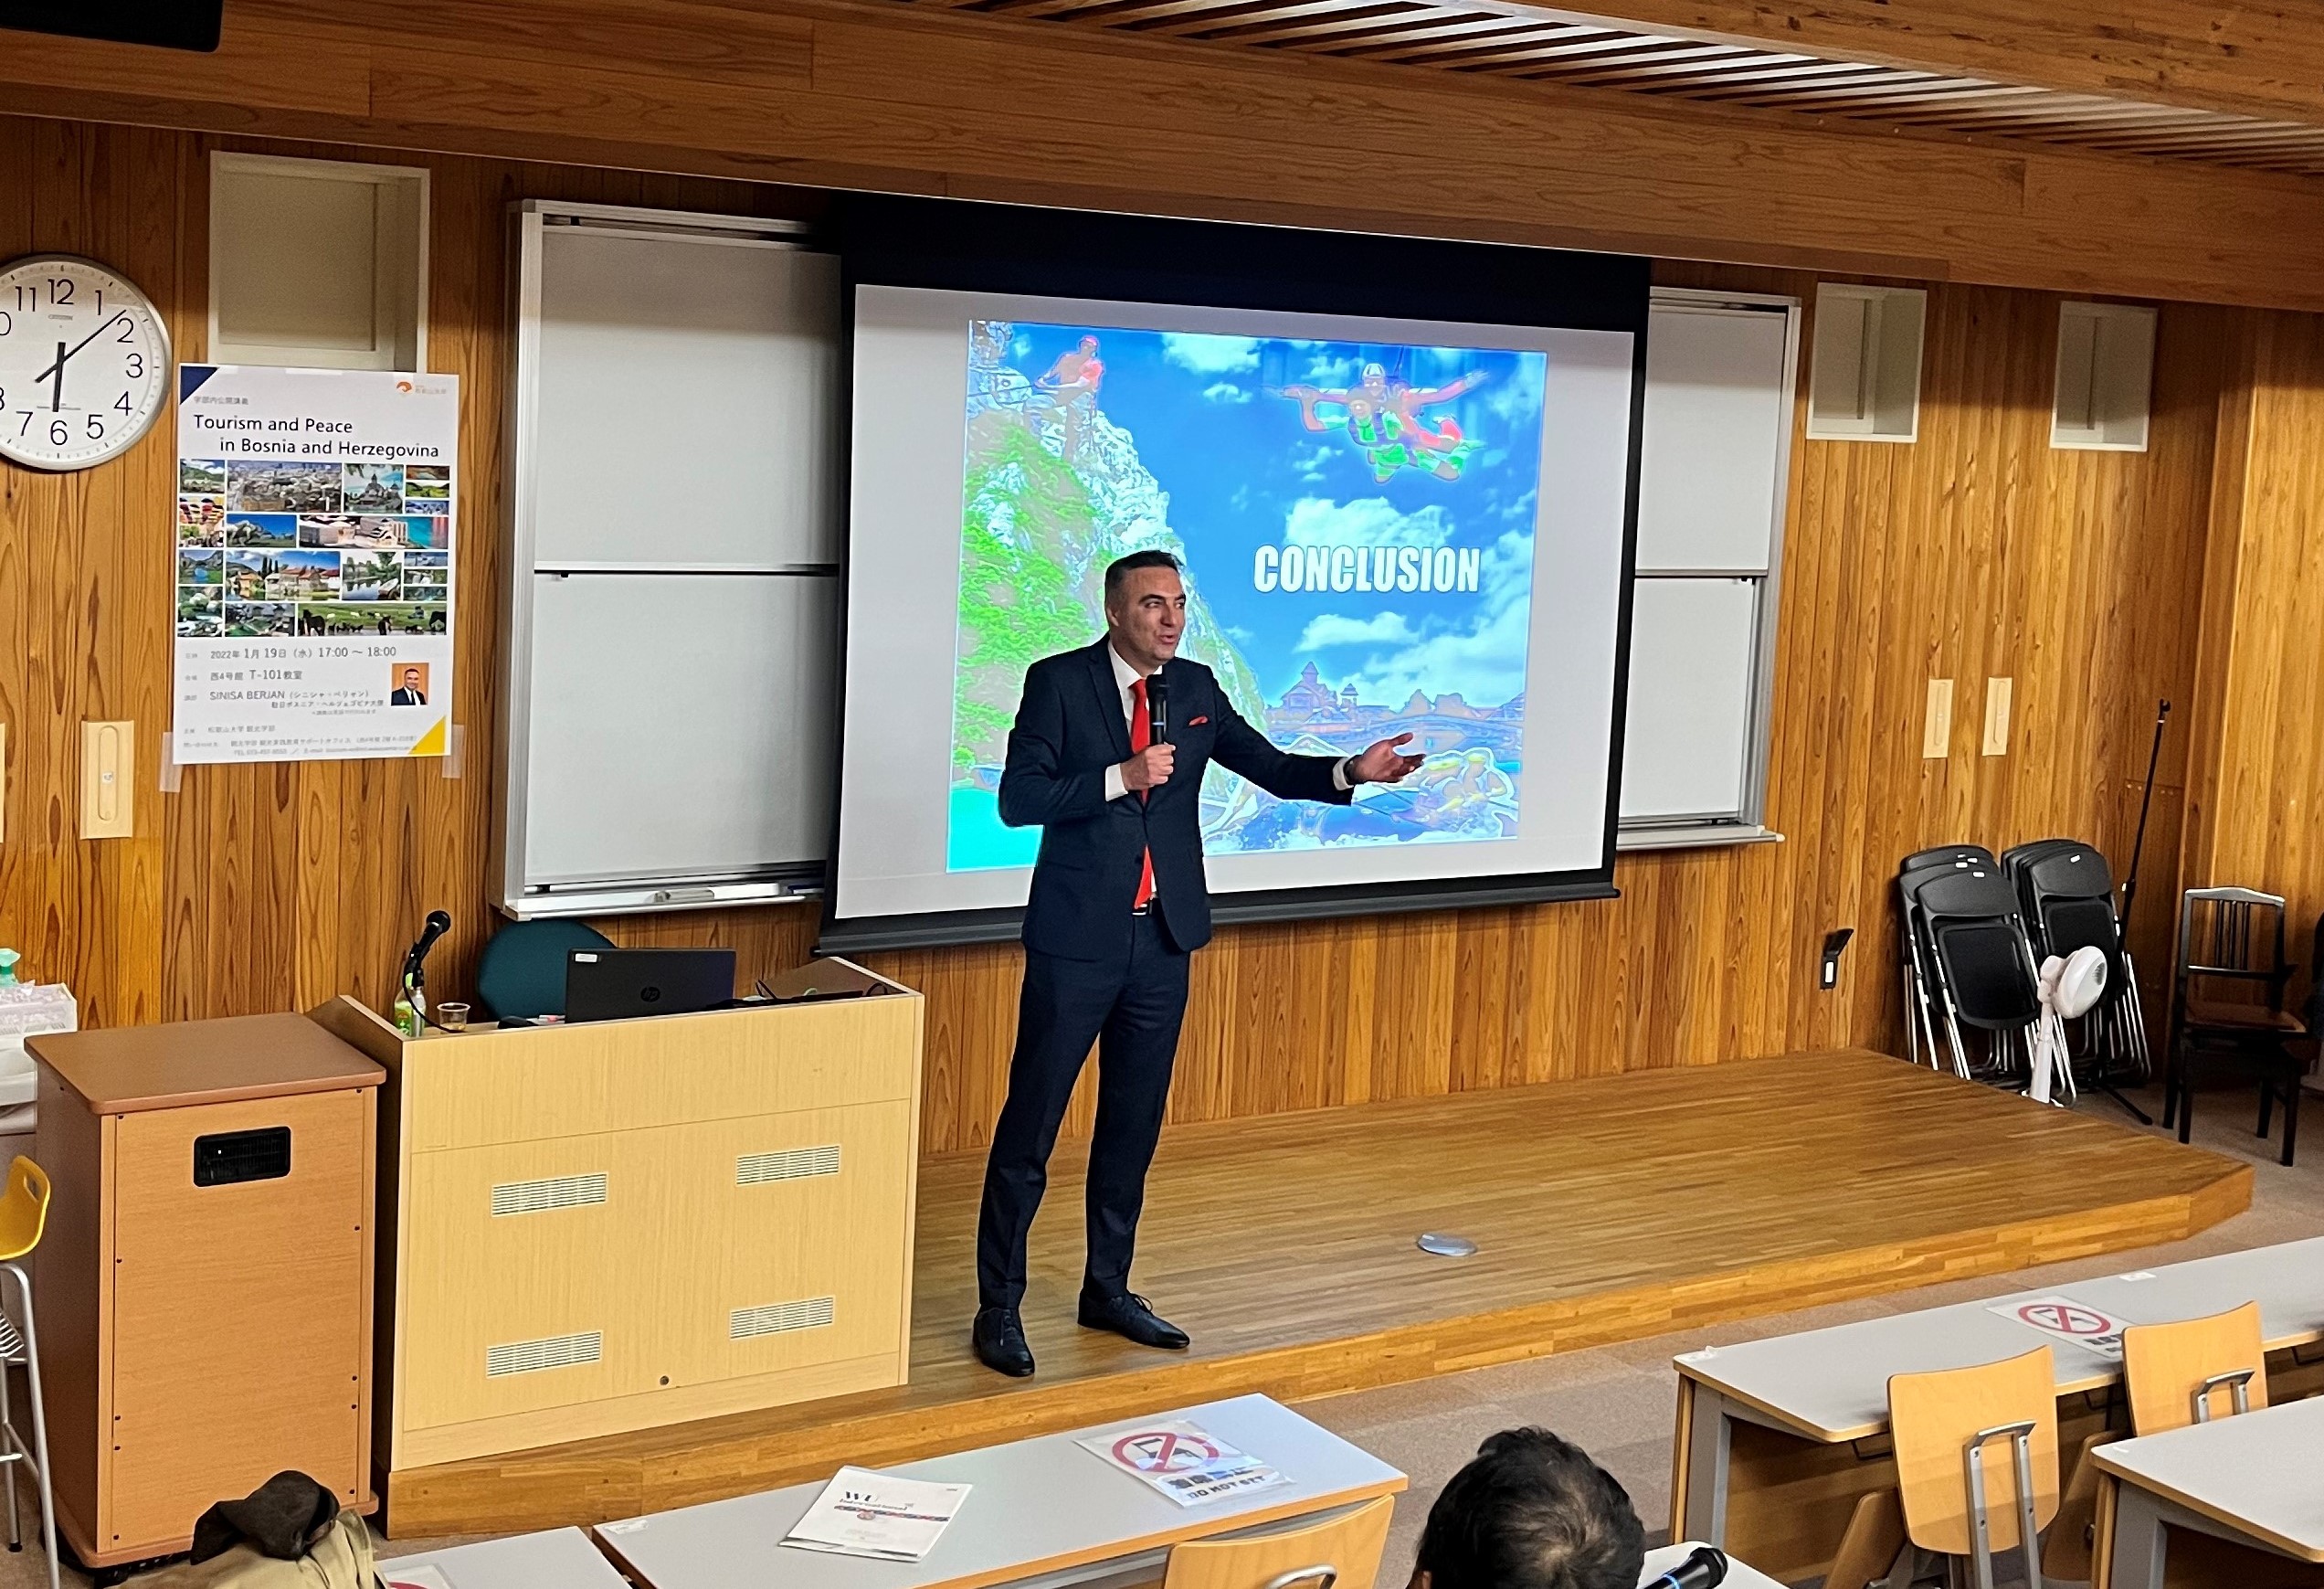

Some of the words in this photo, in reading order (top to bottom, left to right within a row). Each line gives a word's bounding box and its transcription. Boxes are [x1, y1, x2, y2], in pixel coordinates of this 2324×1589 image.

[15, 286, 37, 312] 11
[48, 279, 75, 305] 12
[95, 290, 102, 315] 1
[117, 318, 134, 344] 2
[125, 353, 143, 378] 3
[113, 391, 133, 416] 4
[16, 410, 34, 436] 7
[50, 420, 69, 445] 6
[86, 414, 104, 440] 5
[194, 414, 262, 431] Tourism
[268, 418, 300, 432] and
[305, 418, 354, 434] Peace
[219, 437, 235, 452] in
[241, 438, 296, 454] Bosnia
[301, 440, 333, 455] and
[338, 440, 439, 460] Herzegovina
[1253, 545, 1482, 593] CONCLUSION
[210, 650, 240, 660] 2022年
[244, 648, 259, 660] 1月
[264, 648, 287, 659] 19日
[318, 646, 349, 658] 17:00
[367, 646, 396, 657] 18:00
[246, 690, 286, 700] BERJAN
